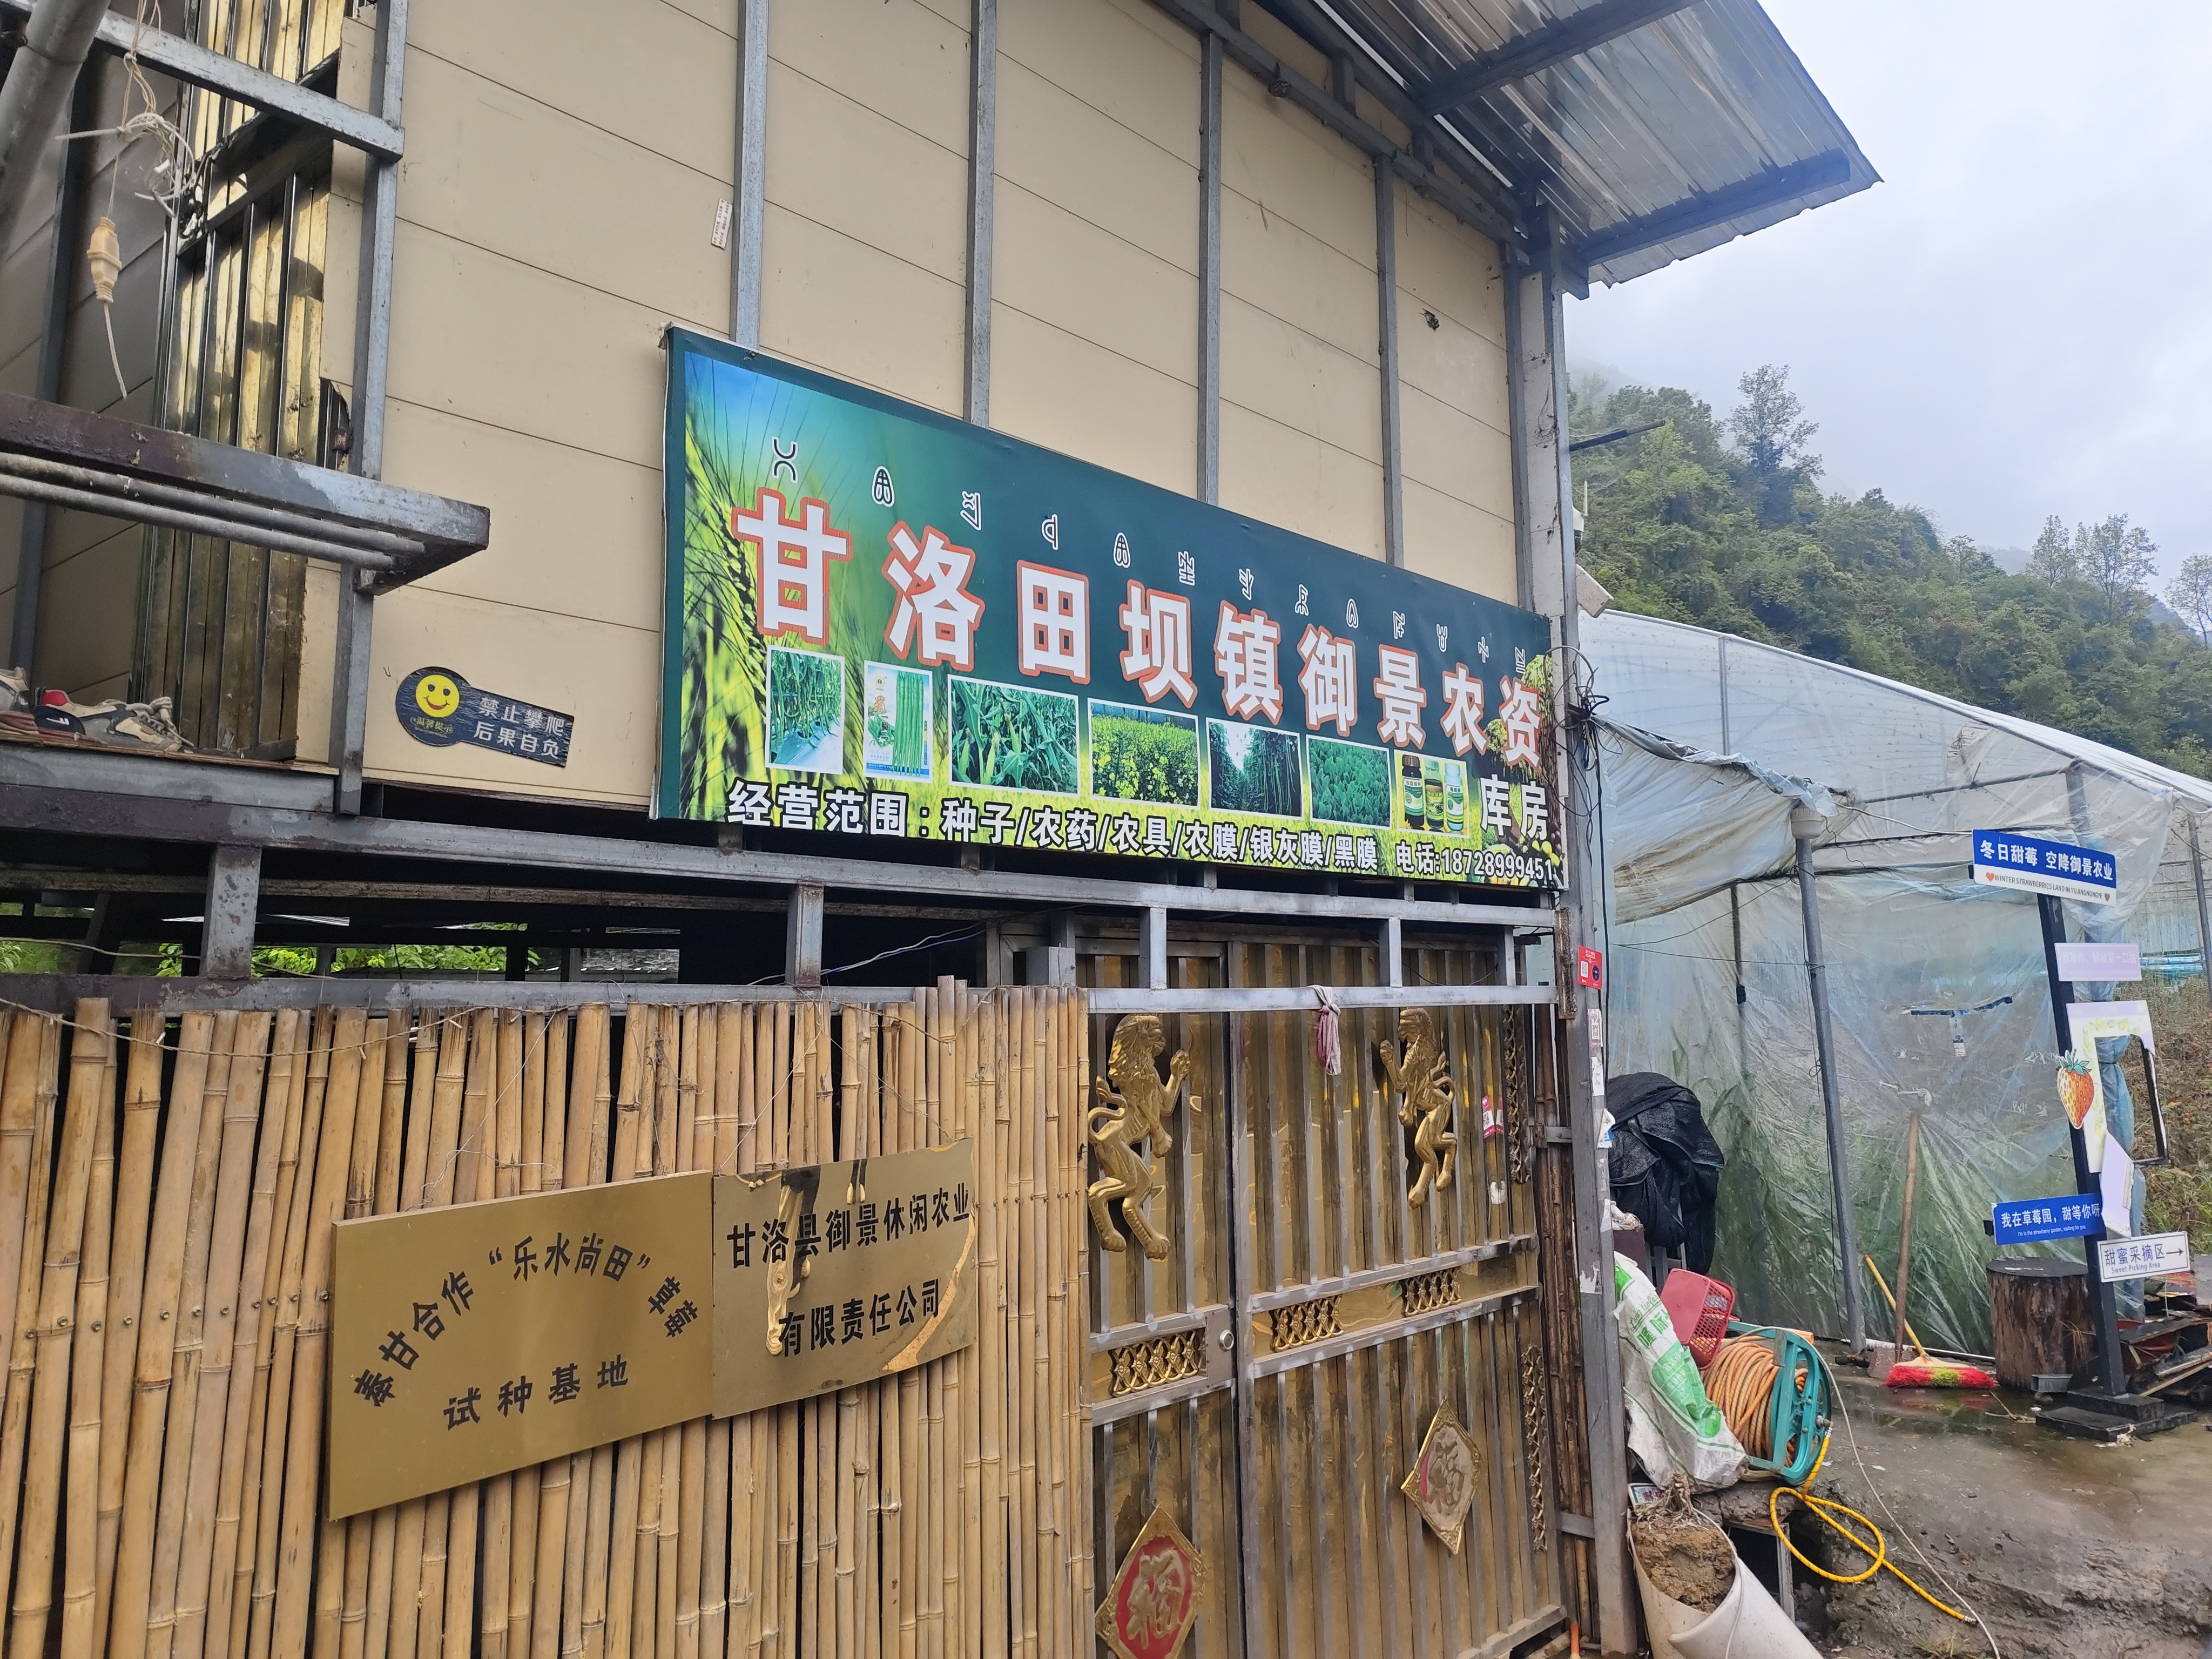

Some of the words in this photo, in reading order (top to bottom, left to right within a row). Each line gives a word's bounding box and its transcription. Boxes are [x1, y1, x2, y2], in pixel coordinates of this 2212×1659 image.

[732, 487, 1542, 770] 甘洛田坝镇御景农资
[477, 697, 565, 737] 禁止攀爬
[473, 721, 559, 759] 后果自负
[1480, 774, 1549, 841] 库房
[1979, 839, 2038, 867] 冬日甜莓
[2046, 851, 2113, 881] 空降御景农业
[1994, 874, 2015, 884] WINTER
[2016, 878, 2052, 890] STRAWBERRIES
[2053, 884, 2065, 892] LAND
[726, 1182, 970, 1270] 甘洛县御景休闲农业
[2104, 1243, 2165, 1266] 甜蜜采摘区
[2111, 1266, 2128, 1274] Sweet
[2128, 1264, 2148, 1272] Picking
[778, 1278, 940, 1357] 有限责任公司
[443, 1354, 629, 1431] 试种基地
